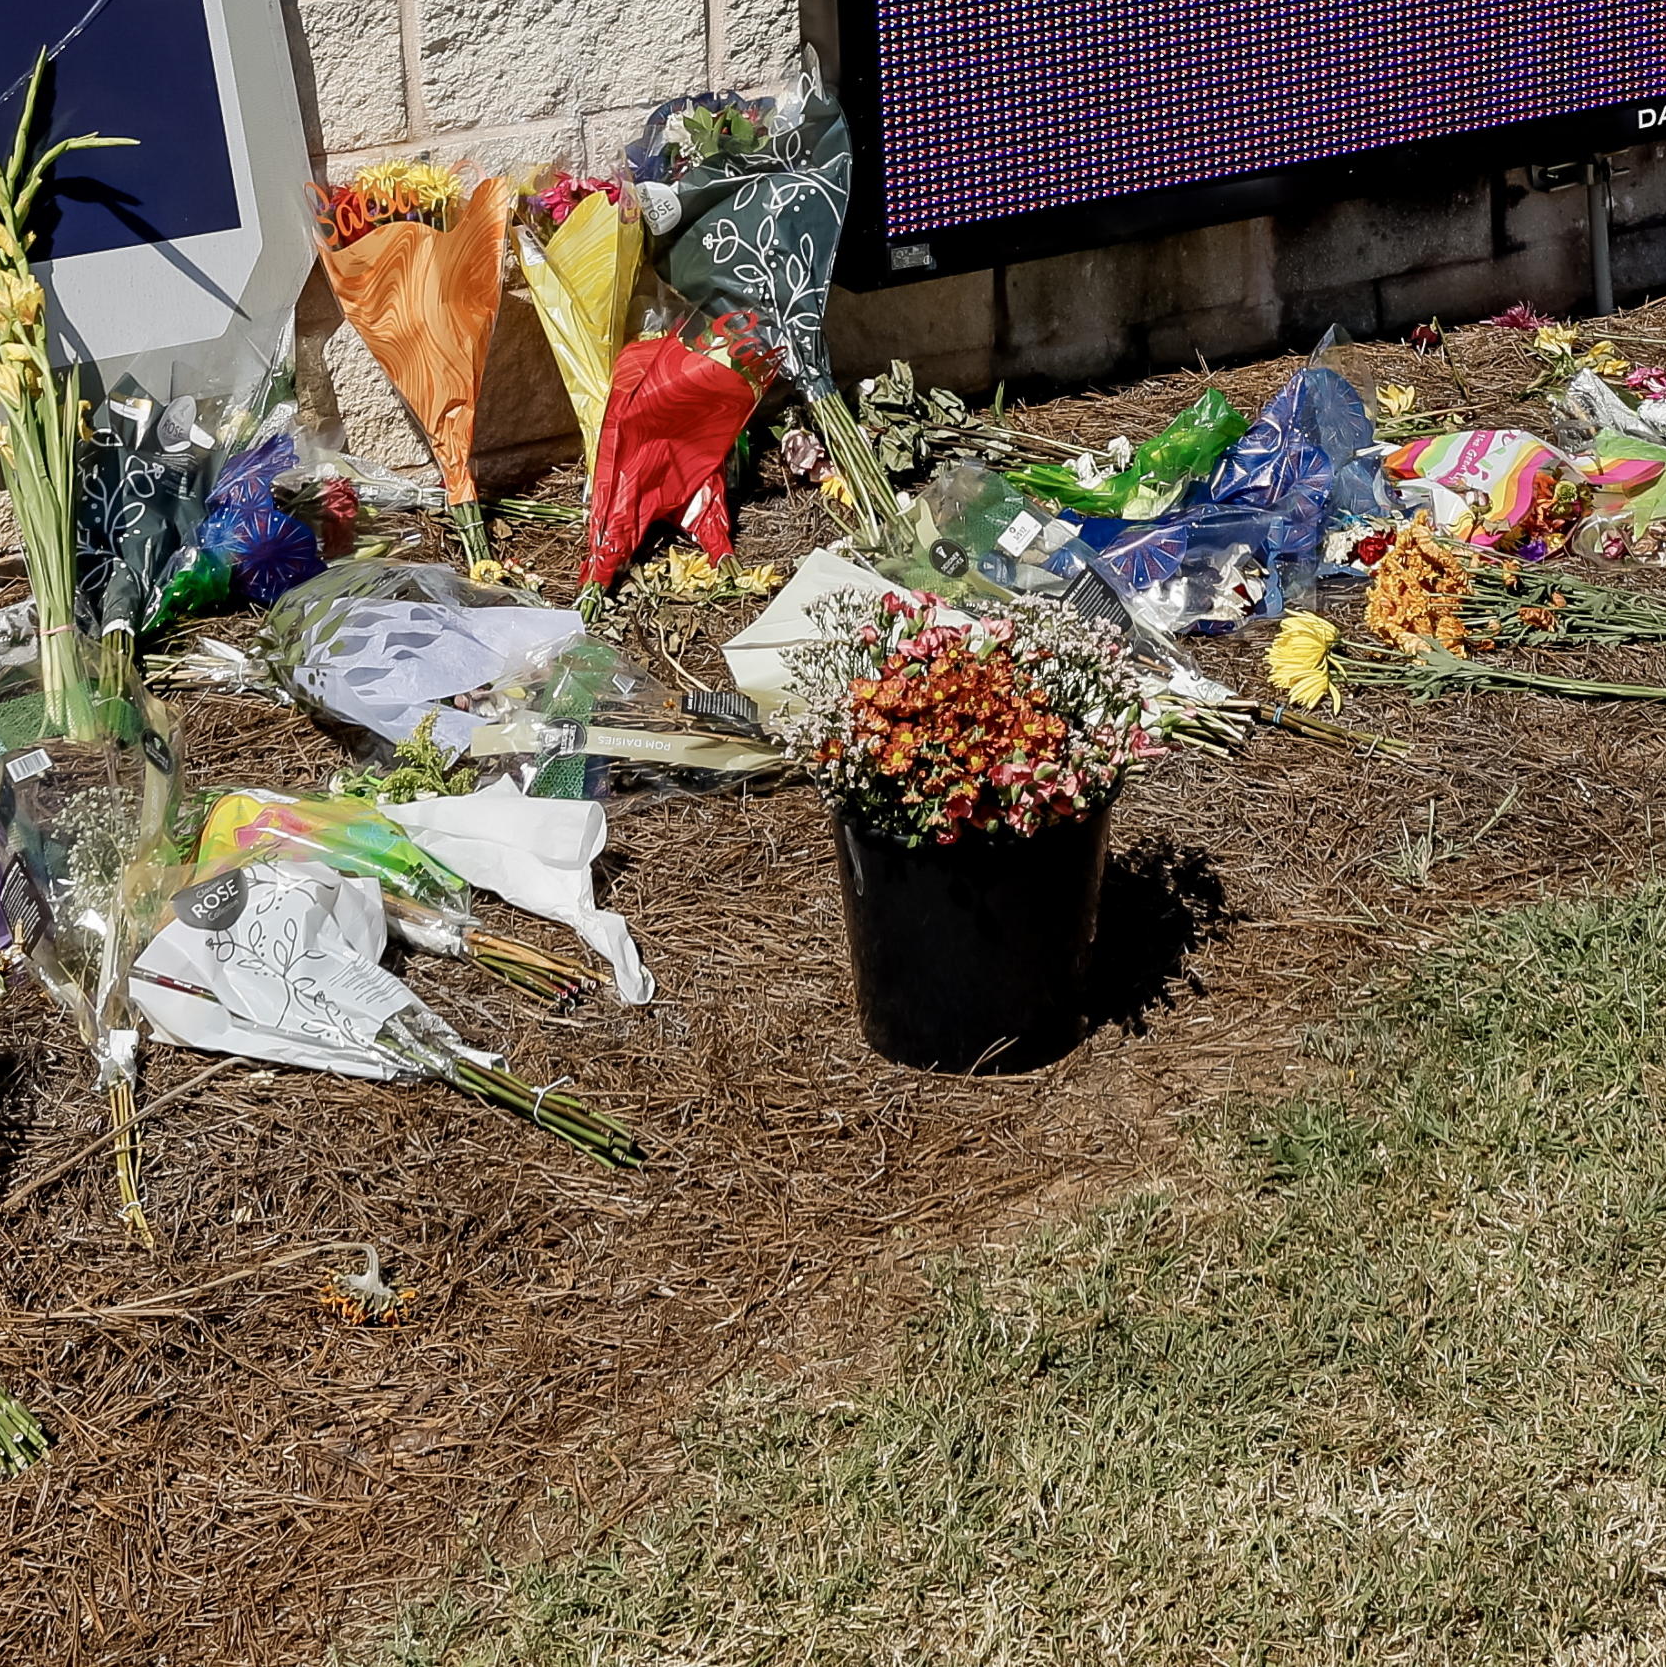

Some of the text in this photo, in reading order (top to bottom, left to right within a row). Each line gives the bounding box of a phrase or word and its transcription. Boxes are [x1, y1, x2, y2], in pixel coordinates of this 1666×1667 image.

[648, 200, 675, 222] OSE
[596, 735, 673, 752] POM DAISIES
[191, 879, 240, 919] ROSE
